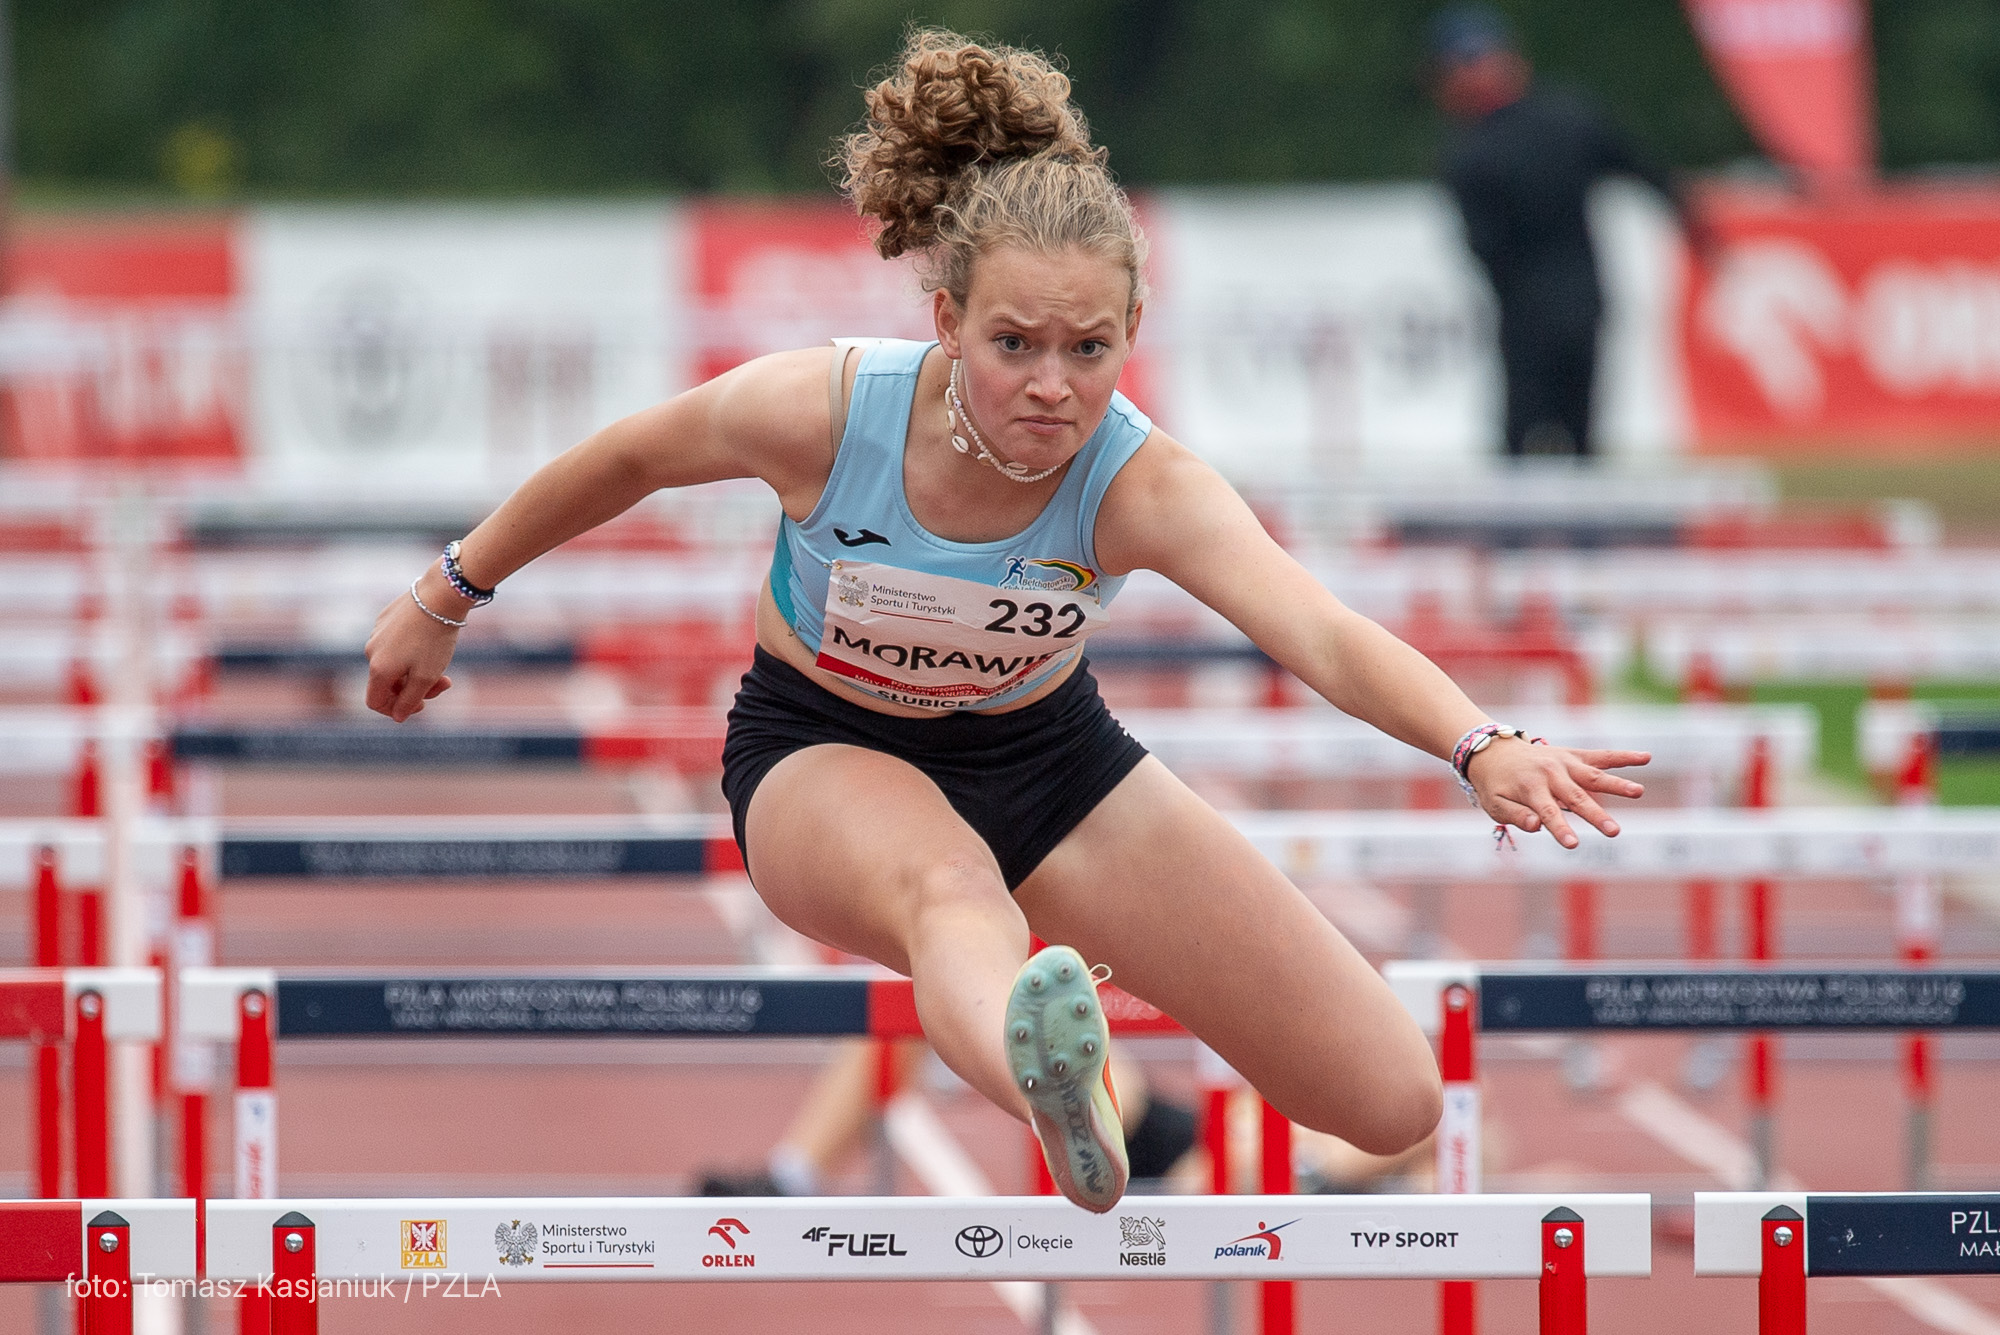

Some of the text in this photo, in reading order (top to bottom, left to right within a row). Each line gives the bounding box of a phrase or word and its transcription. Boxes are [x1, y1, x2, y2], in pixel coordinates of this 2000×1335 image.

[872, 583, 936, 603] Ministerstwo
[870, 595, 903, 608] Sportu
[911, 601, 956, 615] Turystyki
[984, 598, 1086, 638] 232
[833, 625, 1056, 677] MORAWI
[542, 1224, 627, 1237] Ministerstwo
[1951, 1210, 2000, 1234] PZL
[542, 1240, 655, 1256] Sportu i Turystyki
[802, 1227, 908, 1256] 4F FUEL
[1017, 1234, 1073, 1252] Okęcie
[1350, 1232, 1459, 1248] TVP SPORT
[403, 1252, 445, 1267] PZLA
[702, 1254, 755, 1267] ORLEN
[1214, 1243, 1267, 1260] polanik
